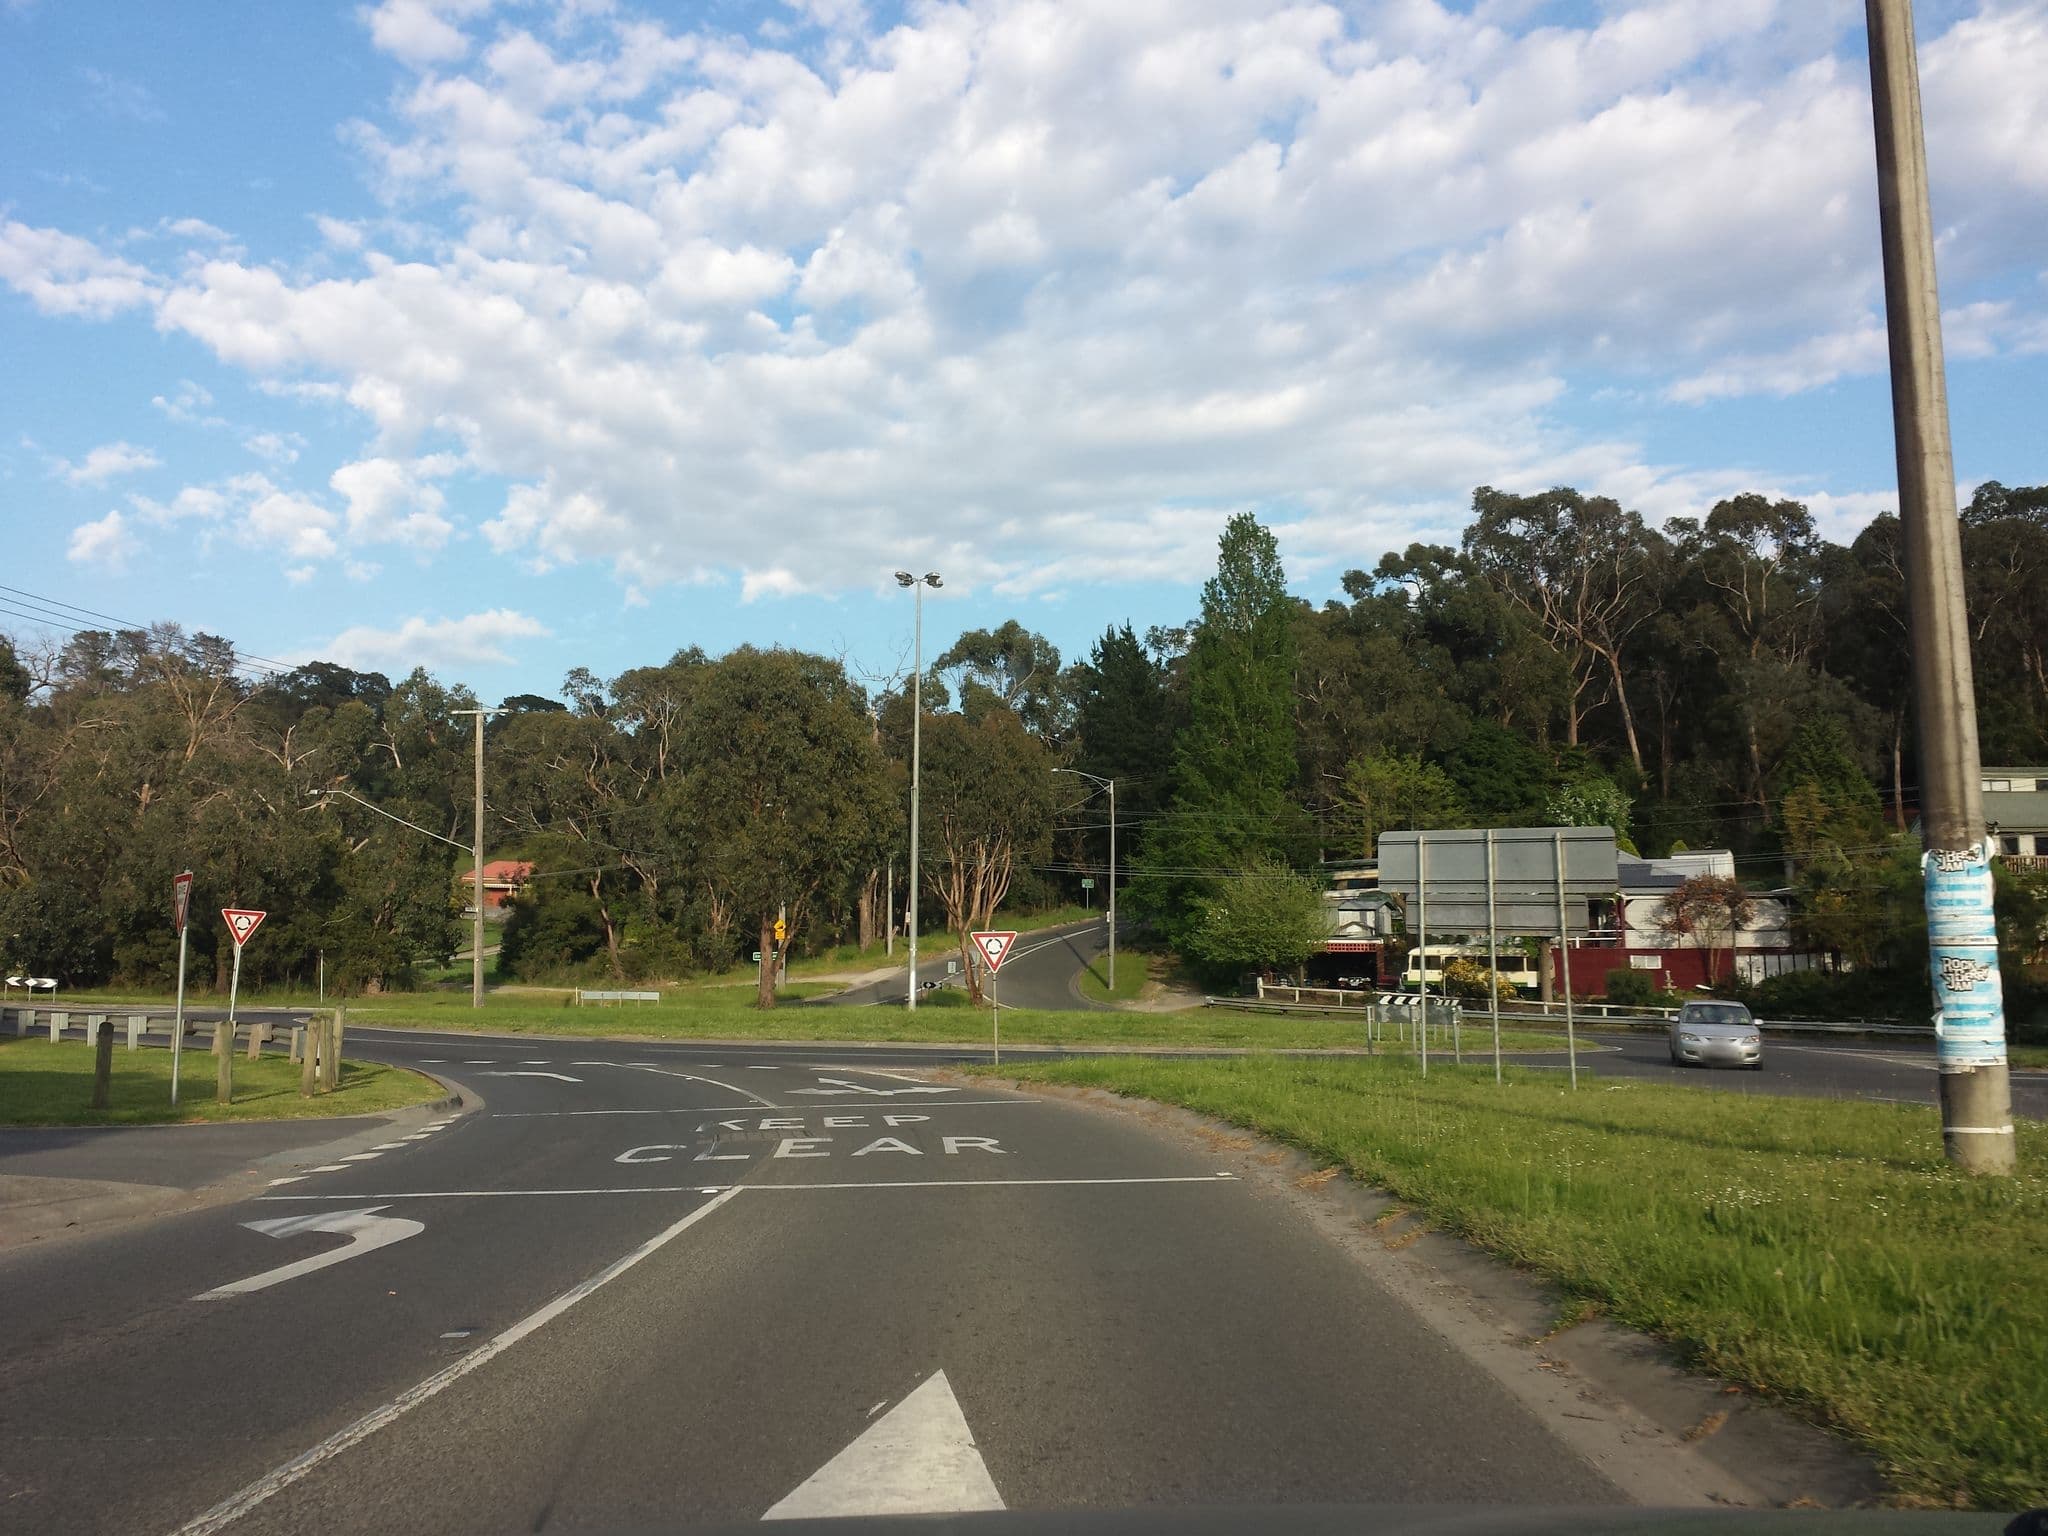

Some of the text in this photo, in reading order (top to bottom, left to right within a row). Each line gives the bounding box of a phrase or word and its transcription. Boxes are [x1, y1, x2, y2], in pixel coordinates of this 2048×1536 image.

[1936, 856, 1964, 872] JAM
[1941, 956, 1976, 973] ROCK
[1945, 973, 1973, 991] JAM
[690, 1114, 931, 1132] KEEP
[613, 1136, 1008, 1164] CLEAR
